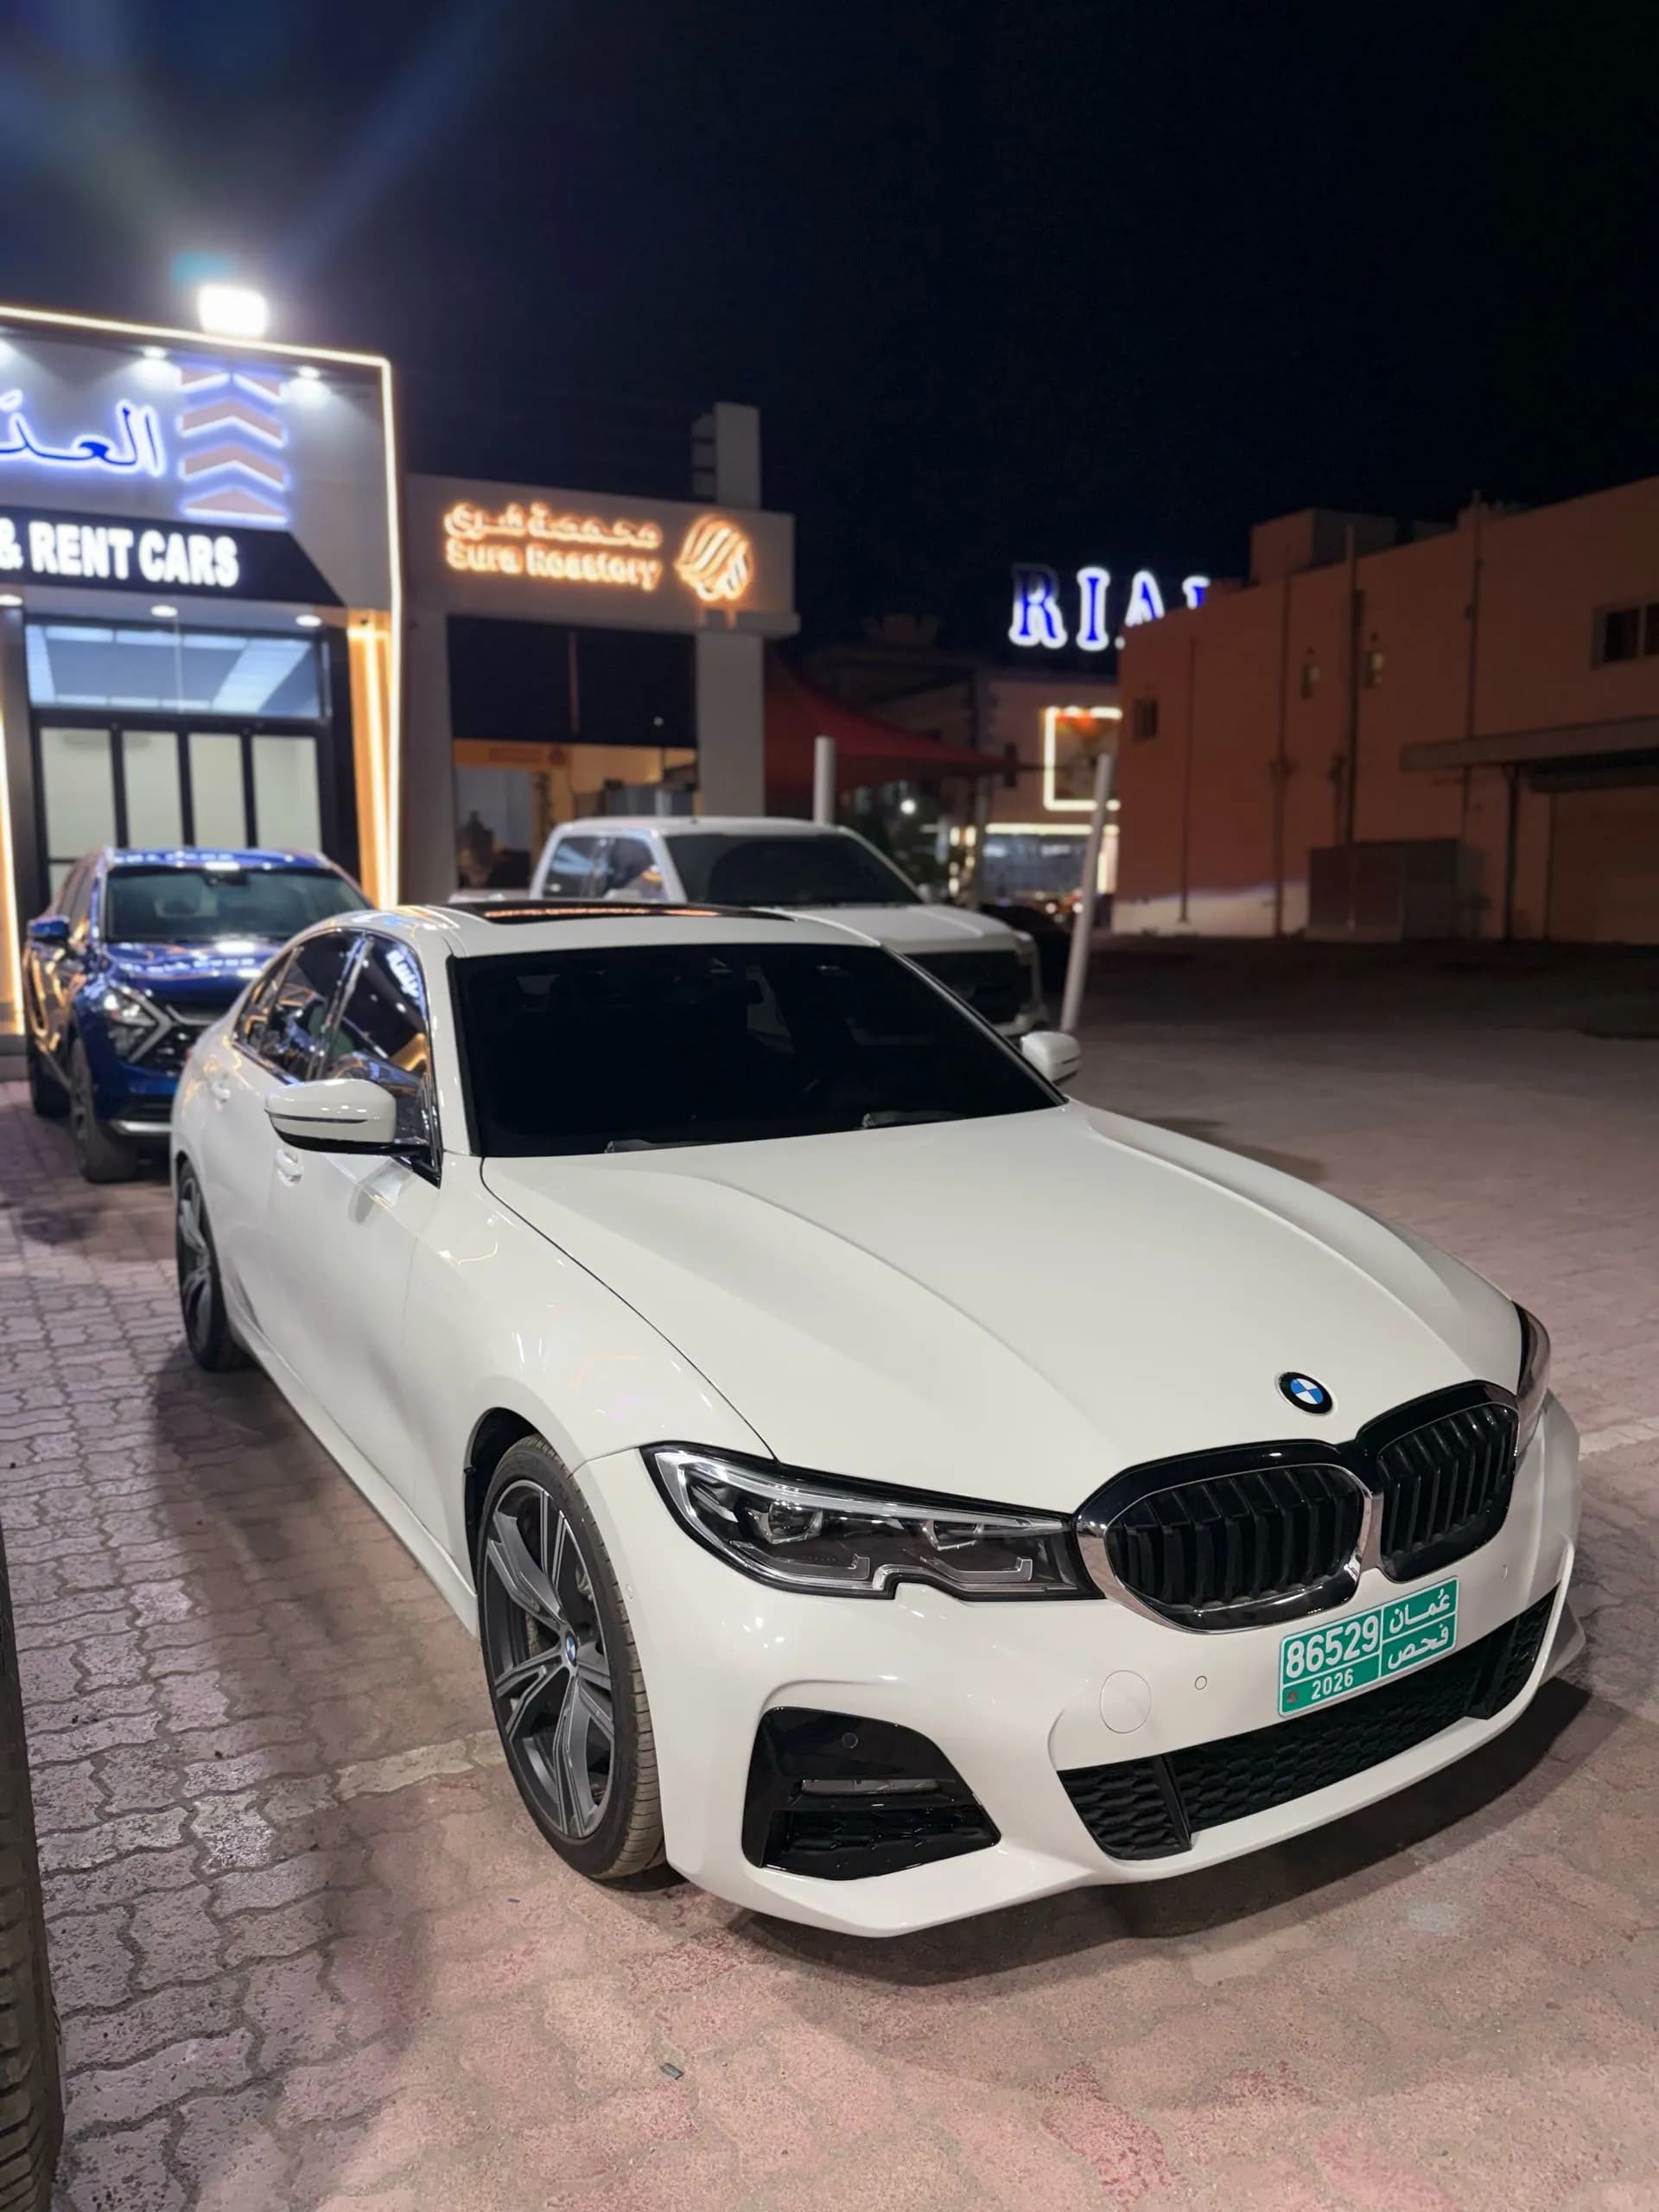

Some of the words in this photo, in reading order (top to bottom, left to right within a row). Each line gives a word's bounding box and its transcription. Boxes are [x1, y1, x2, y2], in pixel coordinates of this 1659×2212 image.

[29, 520, 134, 581] RENT
[138, 529, 240, 588] CARS
[1008, 564, 1210, 652] RIA
[1285, 1614, 1380, 1679] 86529
[1311, 1668, 1354, 1700] 2026
